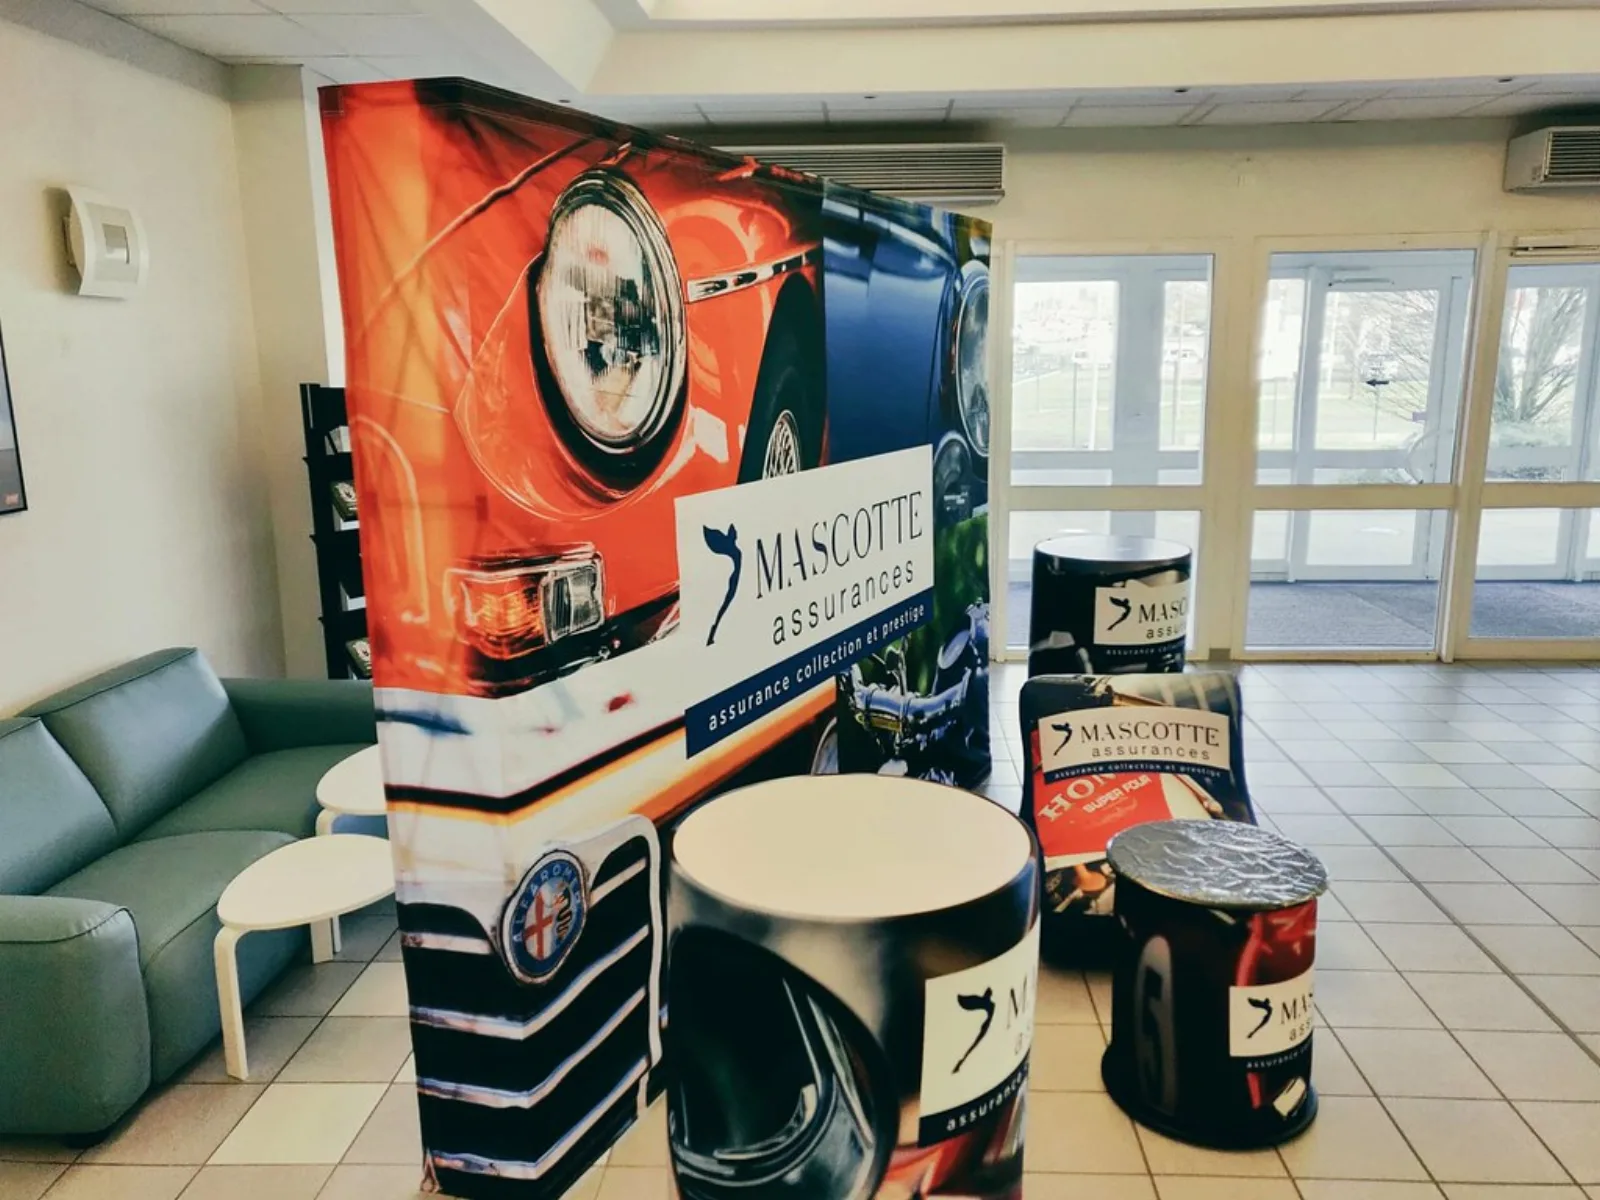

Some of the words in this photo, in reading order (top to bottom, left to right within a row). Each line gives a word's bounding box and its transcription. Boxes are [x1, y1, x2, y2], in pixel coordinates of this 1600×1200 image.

[755, 491, 923, 599] MASCOTTE
[772, 560, 914, 646] assurances
[708, 677, 790, 731] assurance
[796, 636, 863, 683] collection
[866, 630, 878, 649] et
[881, 603, 925, 639] prestige
[1080, 721, 1220, 748] MASCOTTE
[1091, 743, 1211, 761] assurances
[1108, 762, 1161, 772] collection
[1164, 763, 1175, 772] et
[1179, 765, 1221, 779] prestige
[1082, 788, 1123, 814] SUPER
[1122, 774, 1153, 793] FOUR
[540, 864, 581, 904] ROMO
[946, 1071, 1022, 1132] assurance
